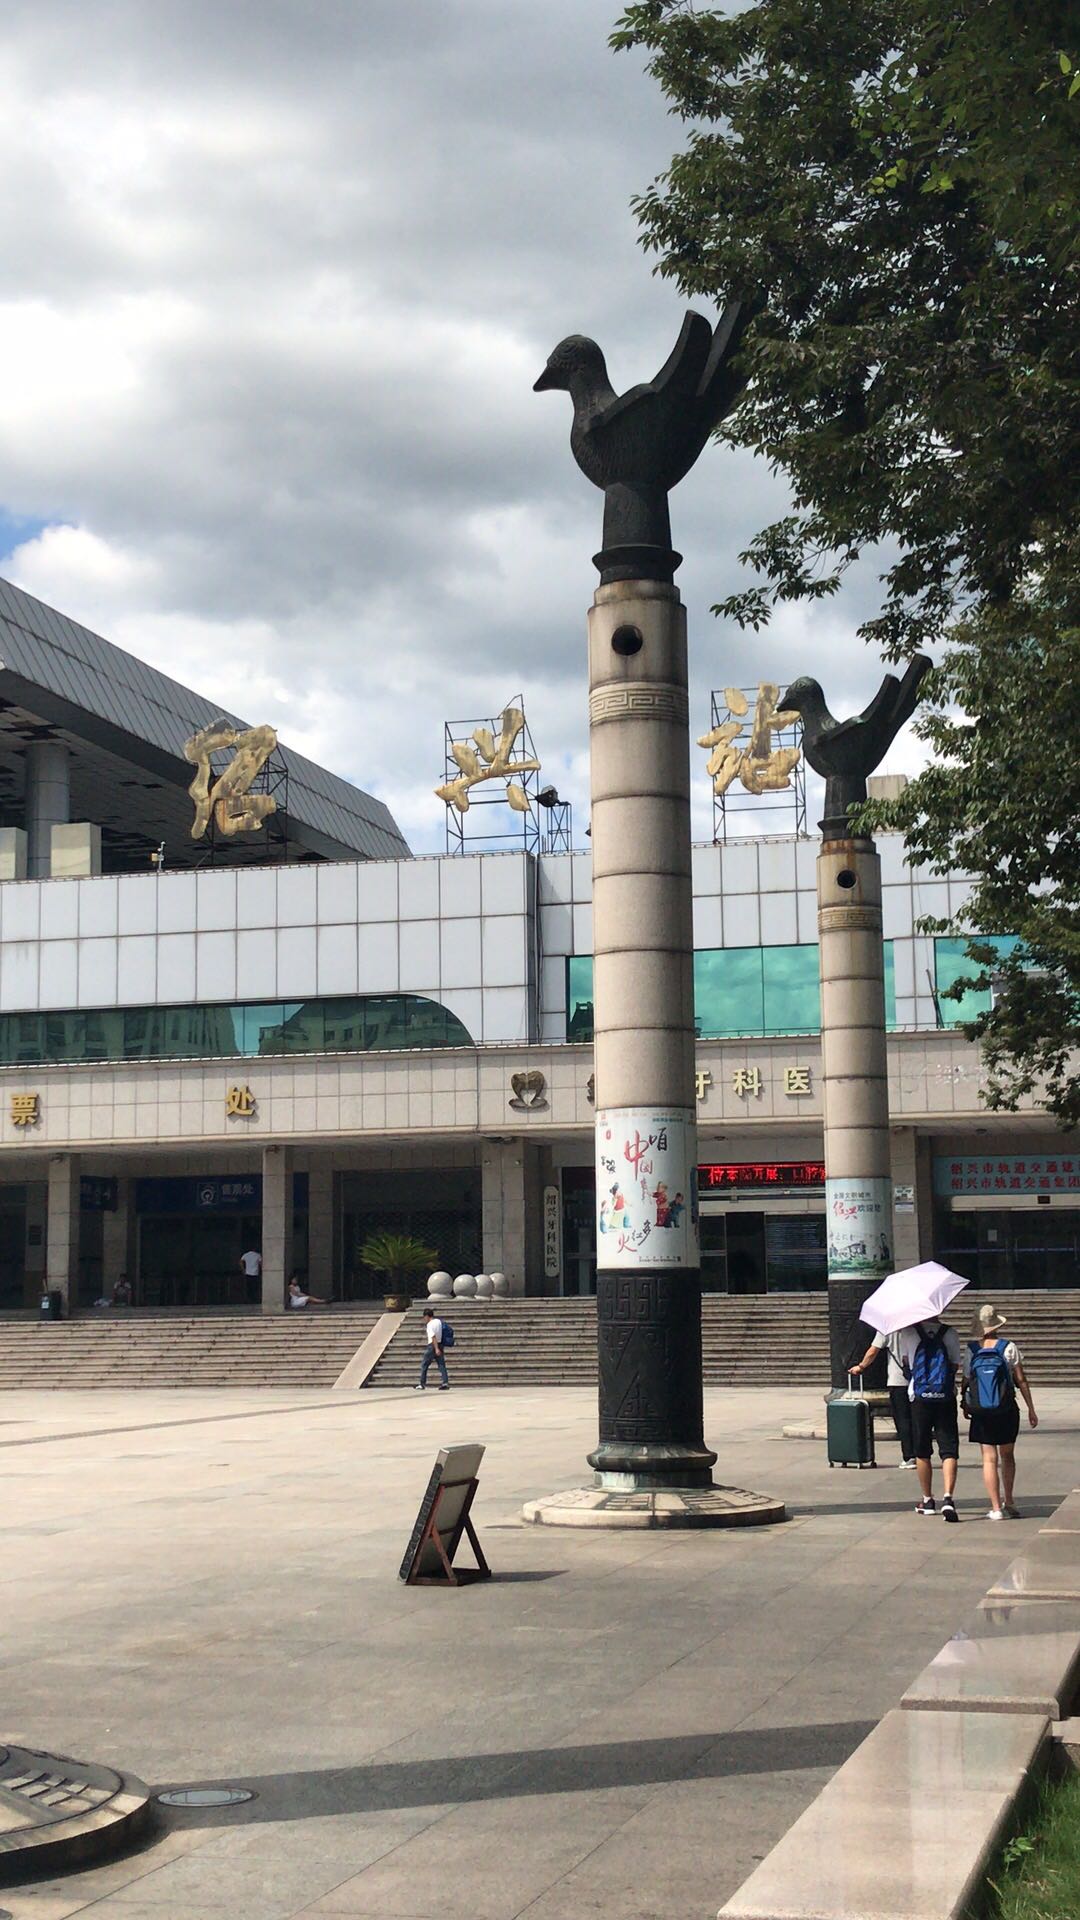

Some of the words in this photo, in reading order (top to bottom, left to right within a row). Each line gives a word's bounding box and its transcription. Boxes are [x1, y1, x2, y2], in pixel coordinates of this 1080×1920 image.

[545, 1193, 558, 1269] 绍兴牙科医院
[921, 1391, 945, 1399] adidas
